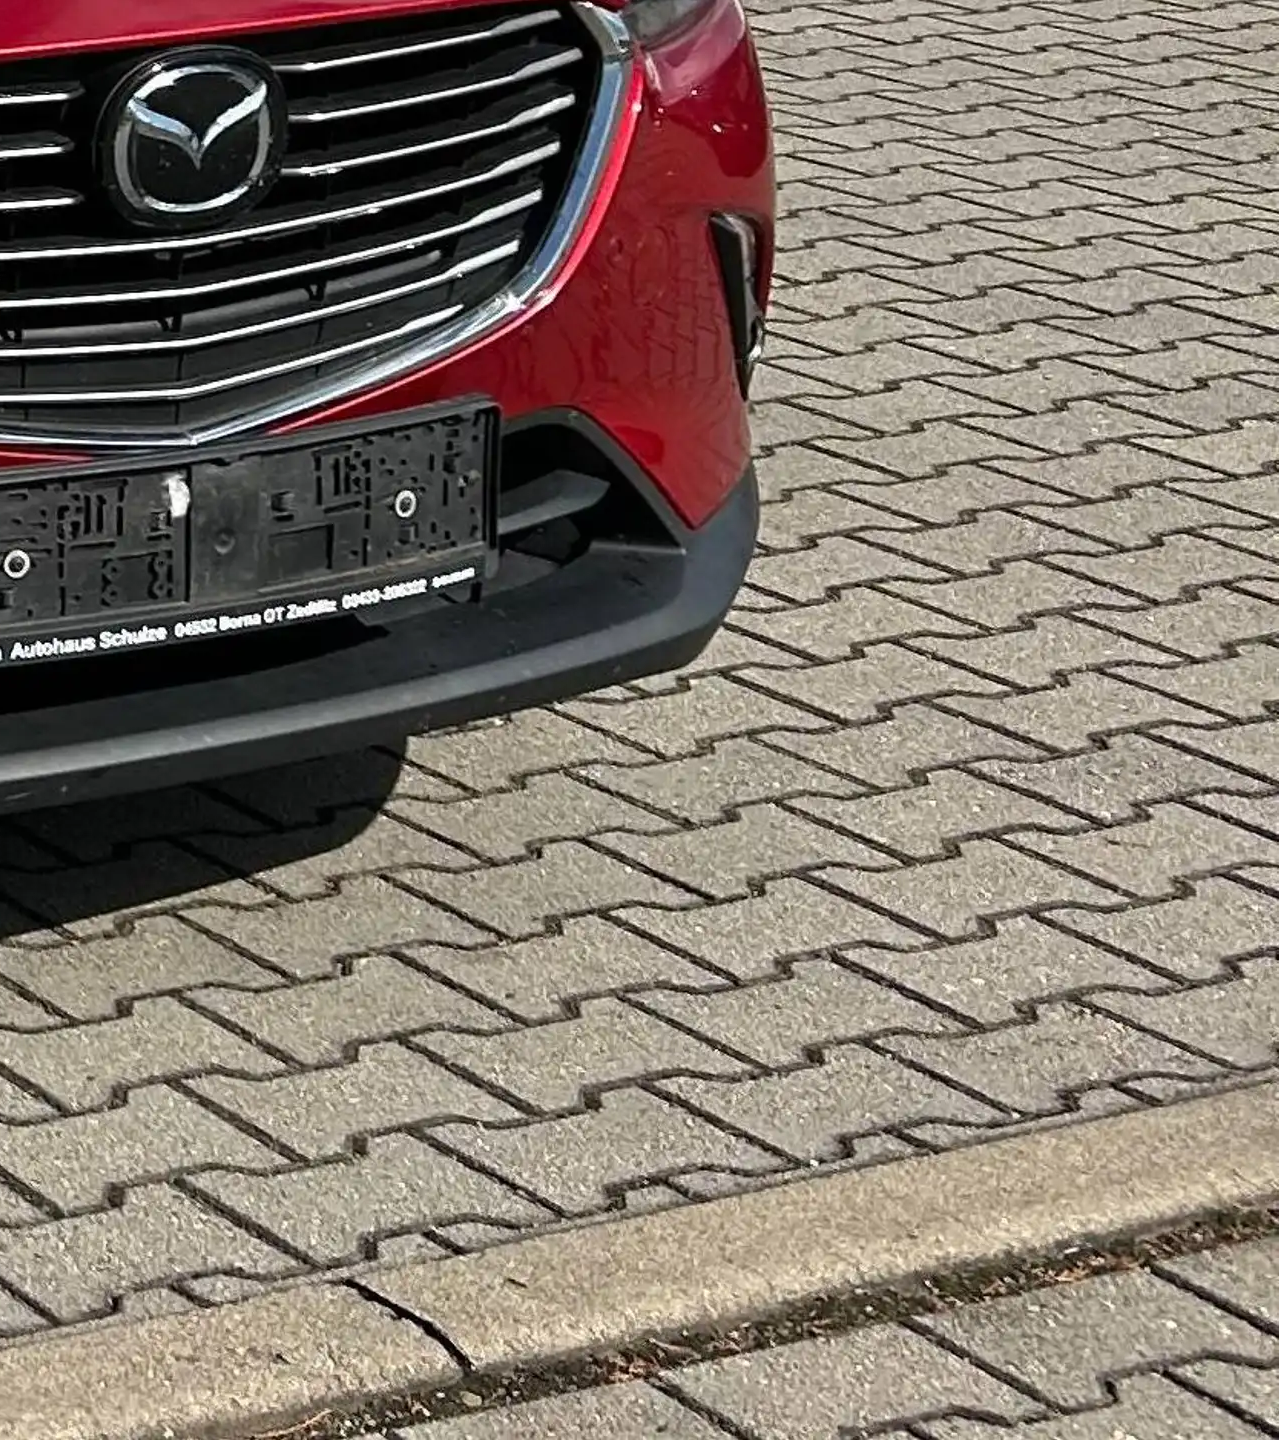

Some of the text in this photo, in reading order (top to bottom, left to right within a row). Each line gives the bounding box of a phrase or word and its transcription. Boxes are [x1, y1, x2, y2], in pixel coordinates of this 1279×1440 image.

[10, 635, 96, 660] Autohaus
[99, 625, 168, 650] Schulze
[218, 612, 262, 631] Borna
[263, 606, 285, 623] OT
